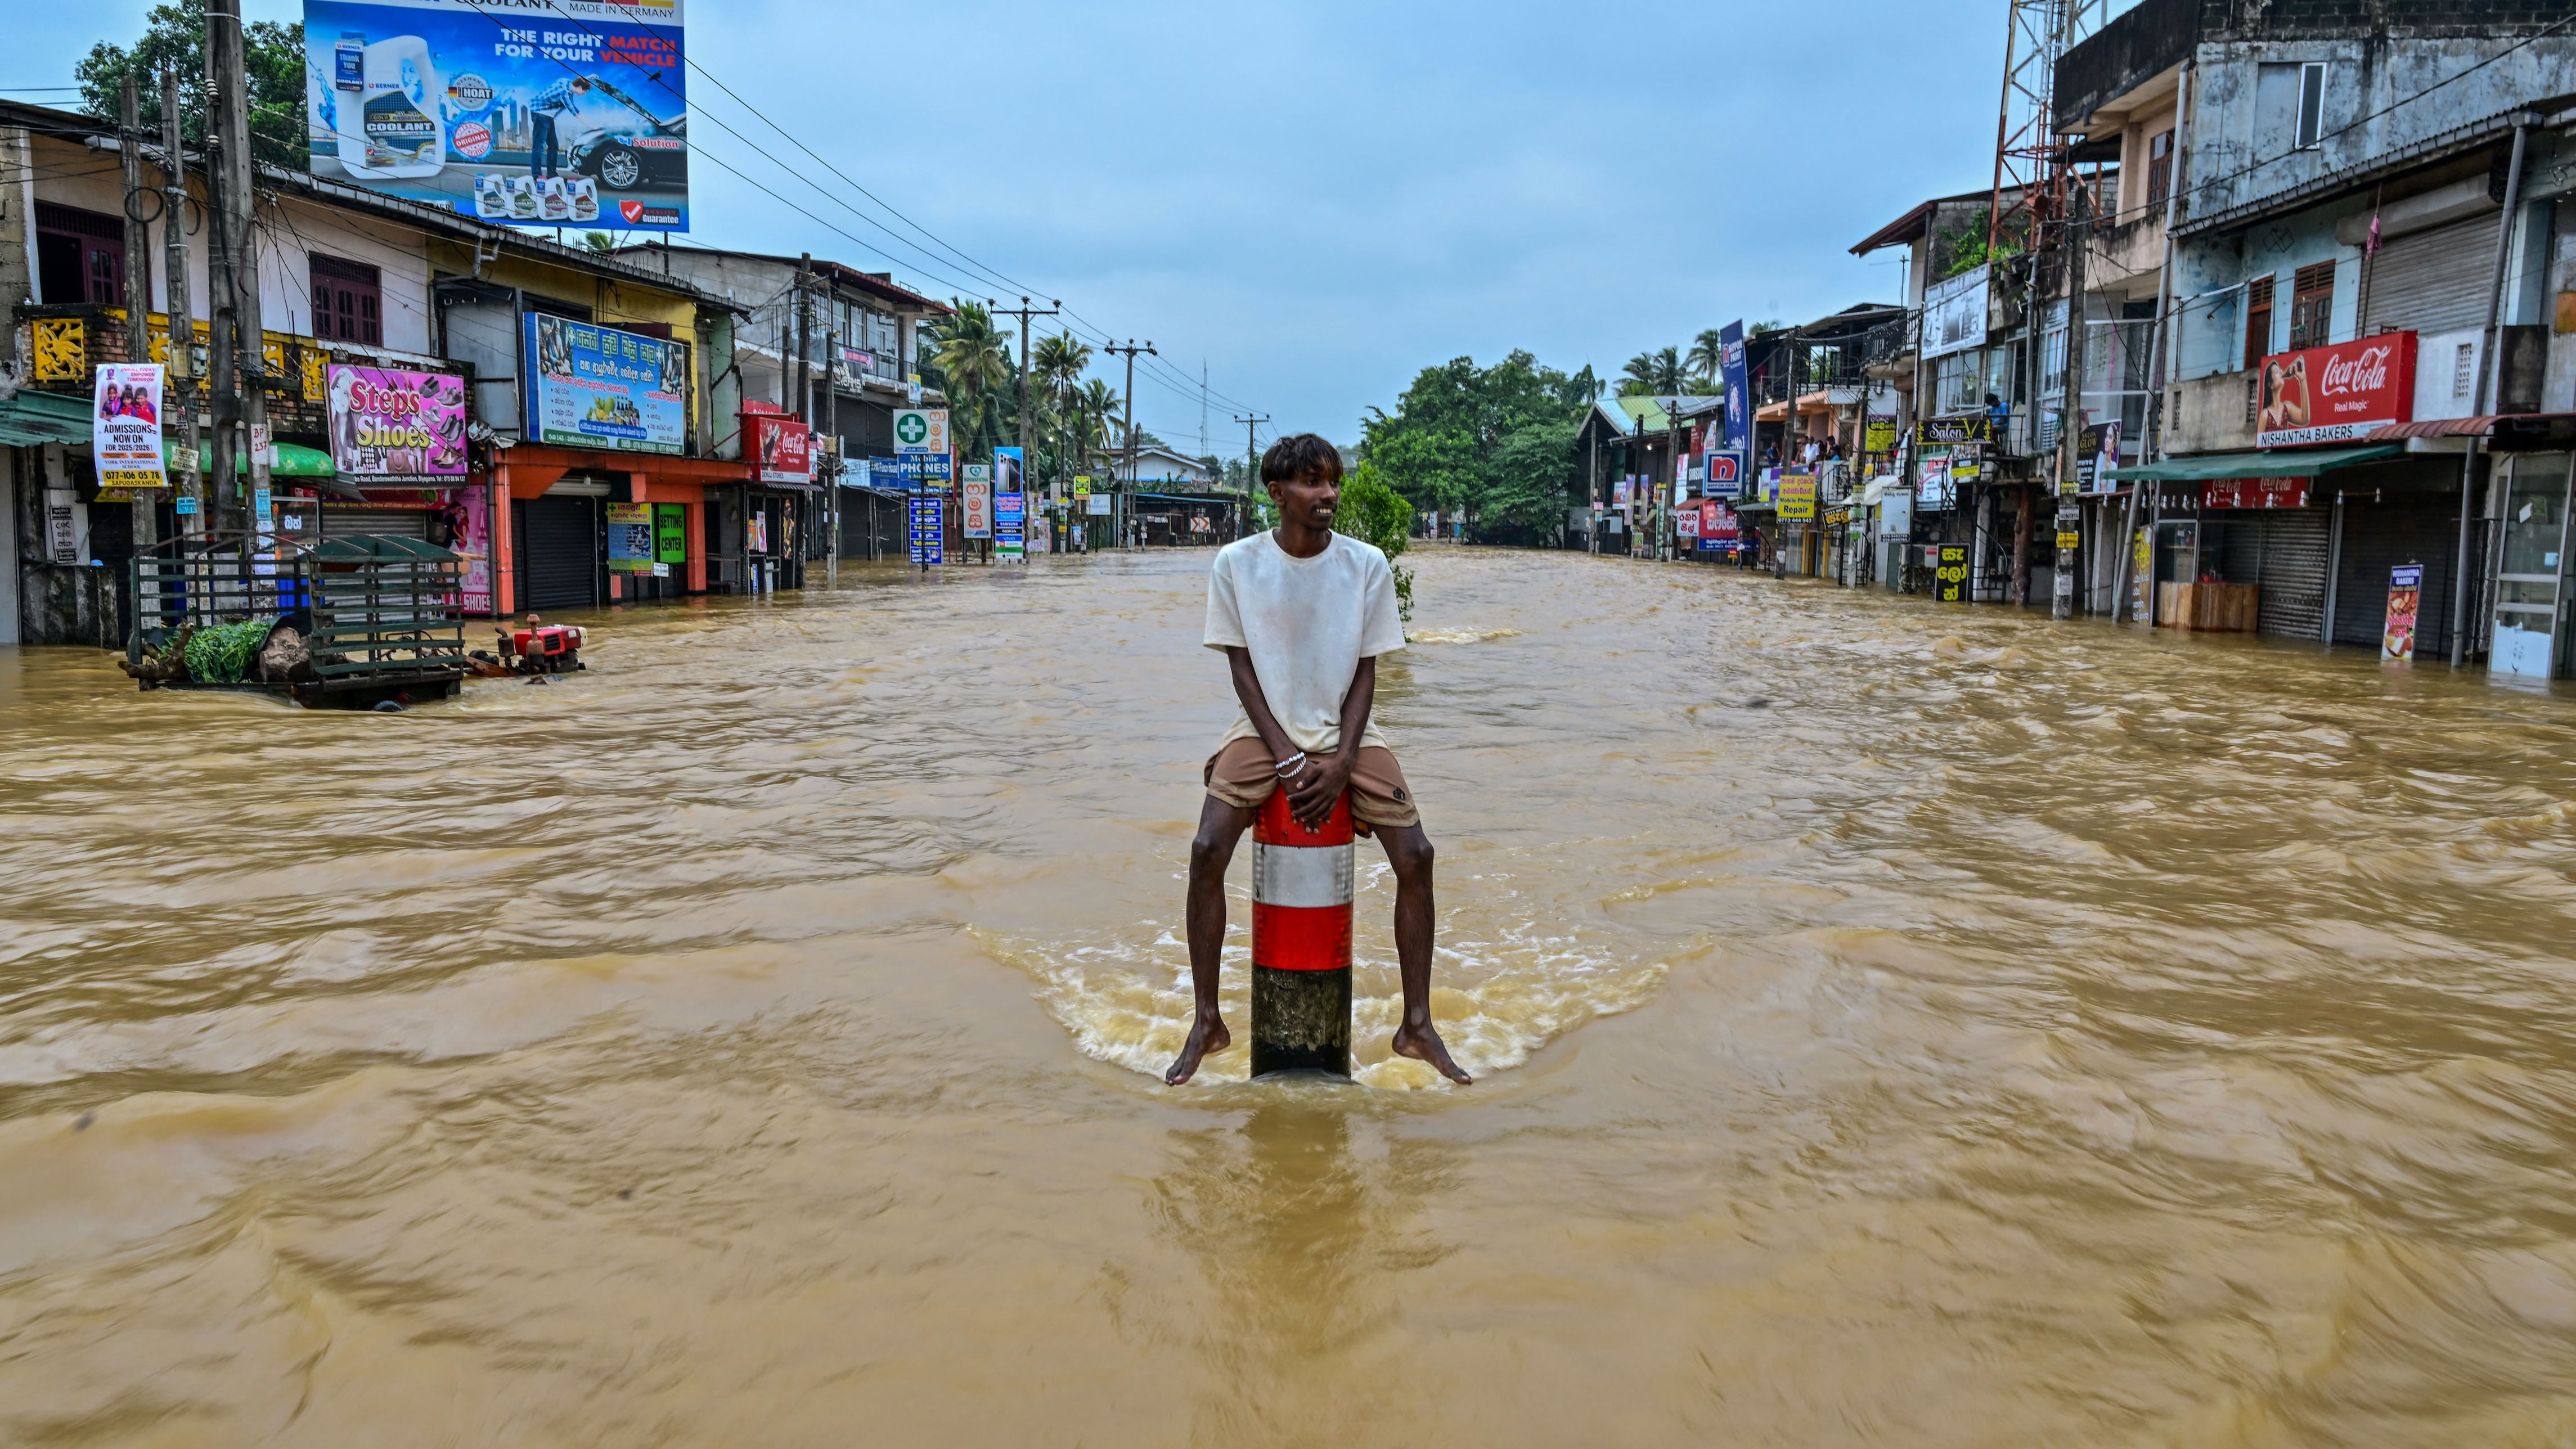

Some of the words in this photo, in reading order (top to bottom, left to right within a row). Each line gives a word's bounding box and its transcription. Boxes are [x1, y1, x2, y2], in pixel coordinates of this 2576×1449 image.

[569, 4, 601, 14] MADE
[605, 6, 617, 15] IN
[619, 6, 674, 18] GERMANY
[501, 29, 537, 43] THE
[543, 31, 603, 47] RIGHT
[609, 36, 675, 52] MATCH
[495, 43, 533, 58] FOR
[540, 46, 594, 62] YOUR
[600, 51, 676, 67] VEHICLE
[463, 88, 491, 98] HOAT
[366, 122, 432, 132] COOLANT
[456, 133, 489, 147] ORIGINAL
[633, 138, 678, 149] Solution
[642, 214, 679, 224] Guarantee
[1728, 339, 1743, 353] NIPPON
[1730, 350, 1742, 363] PAINT
[2322, 345, 2392, 396] Coca-Cola
[349, 379, 421, 421] Steps
[2335, 402, 2348, 412] Real
[2348, 400, 2368, 412] Magic
[104, 425, 152, 434] ADMISSIONS
[254, 428, 264, 438] BP
[357, 415, 430, 449] Shoes
[1929, 422, 1964, 439] Salon
[2261, 428, 2312, 447] NISHANTHA
[2315, 425, 2353, 441] BAKERS
[254, 441, 267, 452] 237
[783, 431, 806, 454] Coca-Cola
[2080, 437, 2097, 449] GLOW
[900, 463, 950, 473] PHONES
[106, 471, 136, 480] 077-106
[138, 471, 148, 480] 05
[150, 471, 160, 480] 78
[1783, 505, 1808, 515] Repair
[659, 514, 682, 529] BETTING
[661, 537, 682, 552] CENTER
[2393, 569, 2420, 577] NISHANTHA
[464, 594, 491, 611] SHOES
